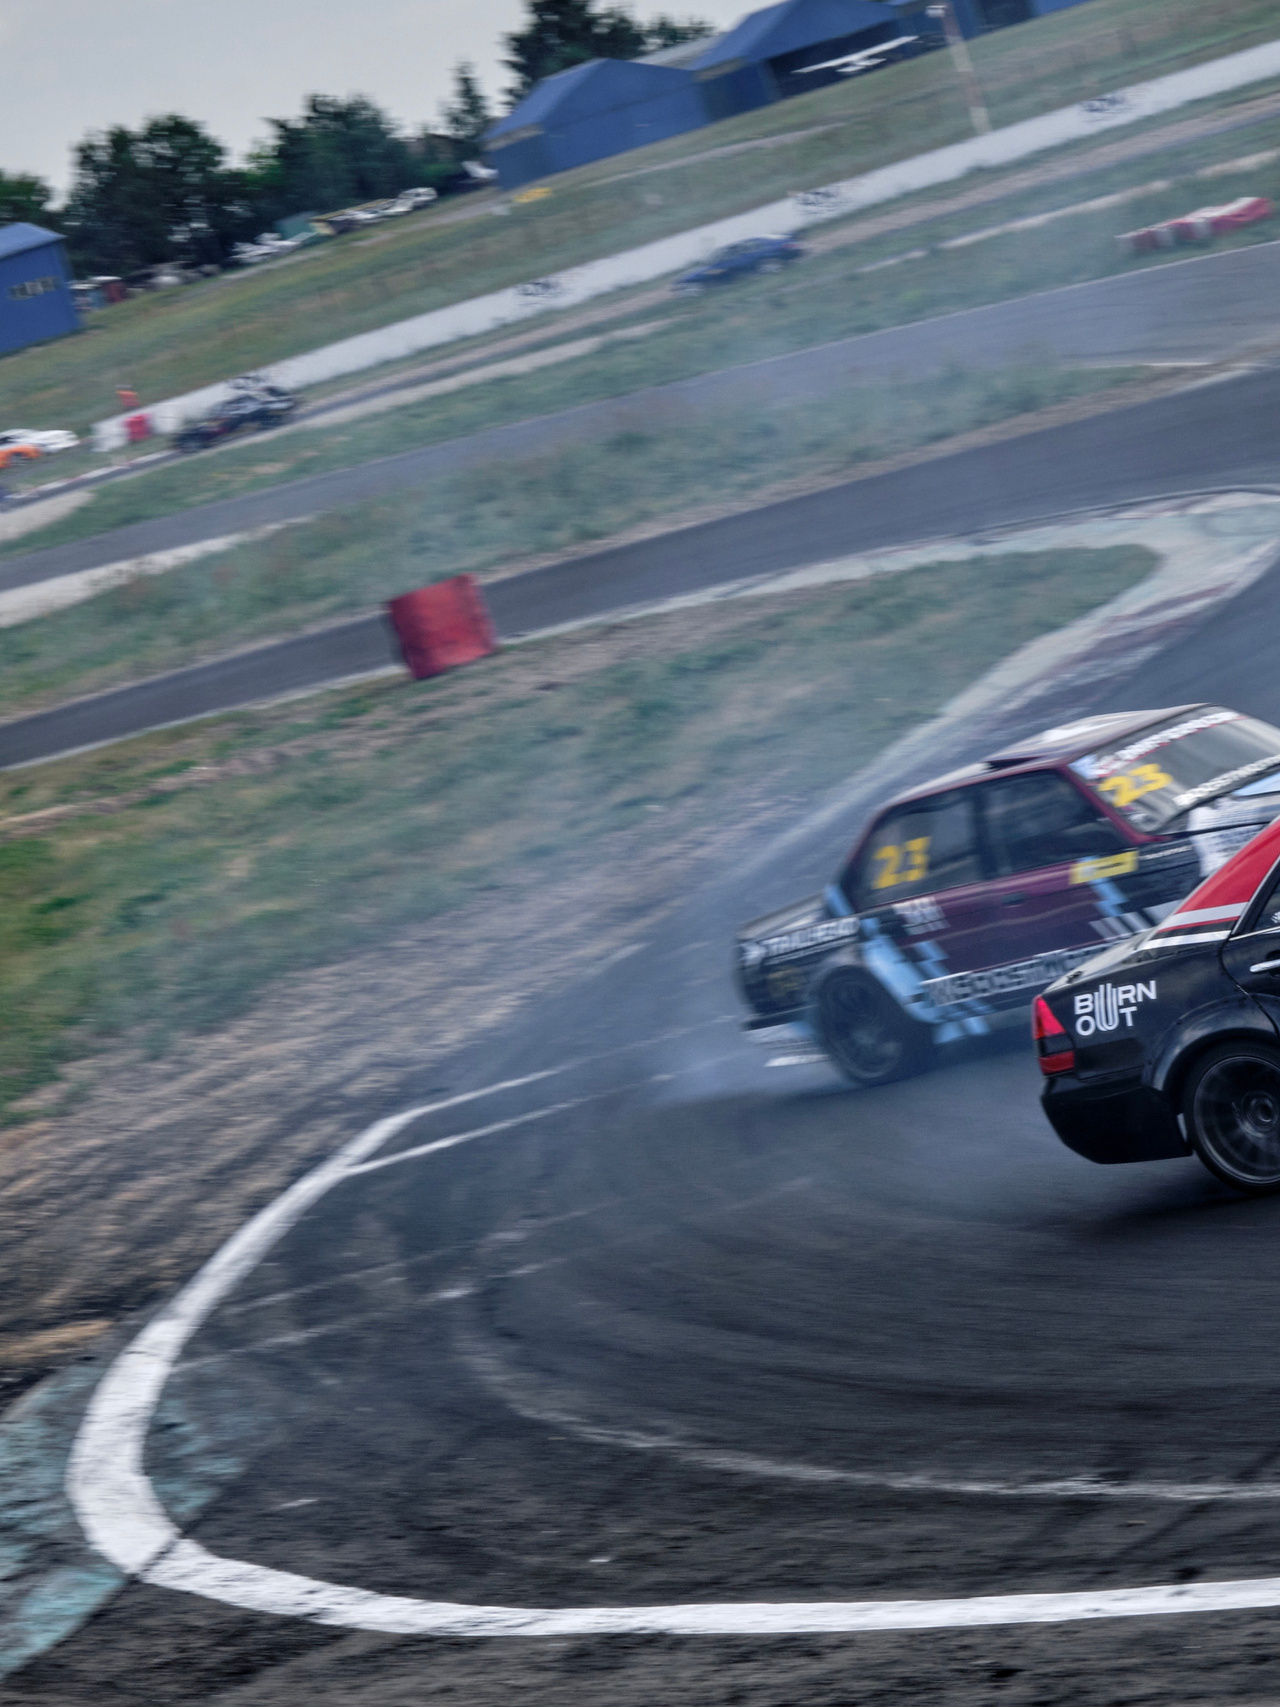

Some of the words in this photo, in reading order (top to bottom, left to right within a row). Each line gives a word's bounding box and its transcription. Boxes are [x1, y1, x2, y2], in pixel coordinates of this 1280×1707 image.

[1099, 763, 1173, 808] 23
[1074, 980, 1157, 1020] BURN
[1075, 1004, 1138, 1036] OUT
